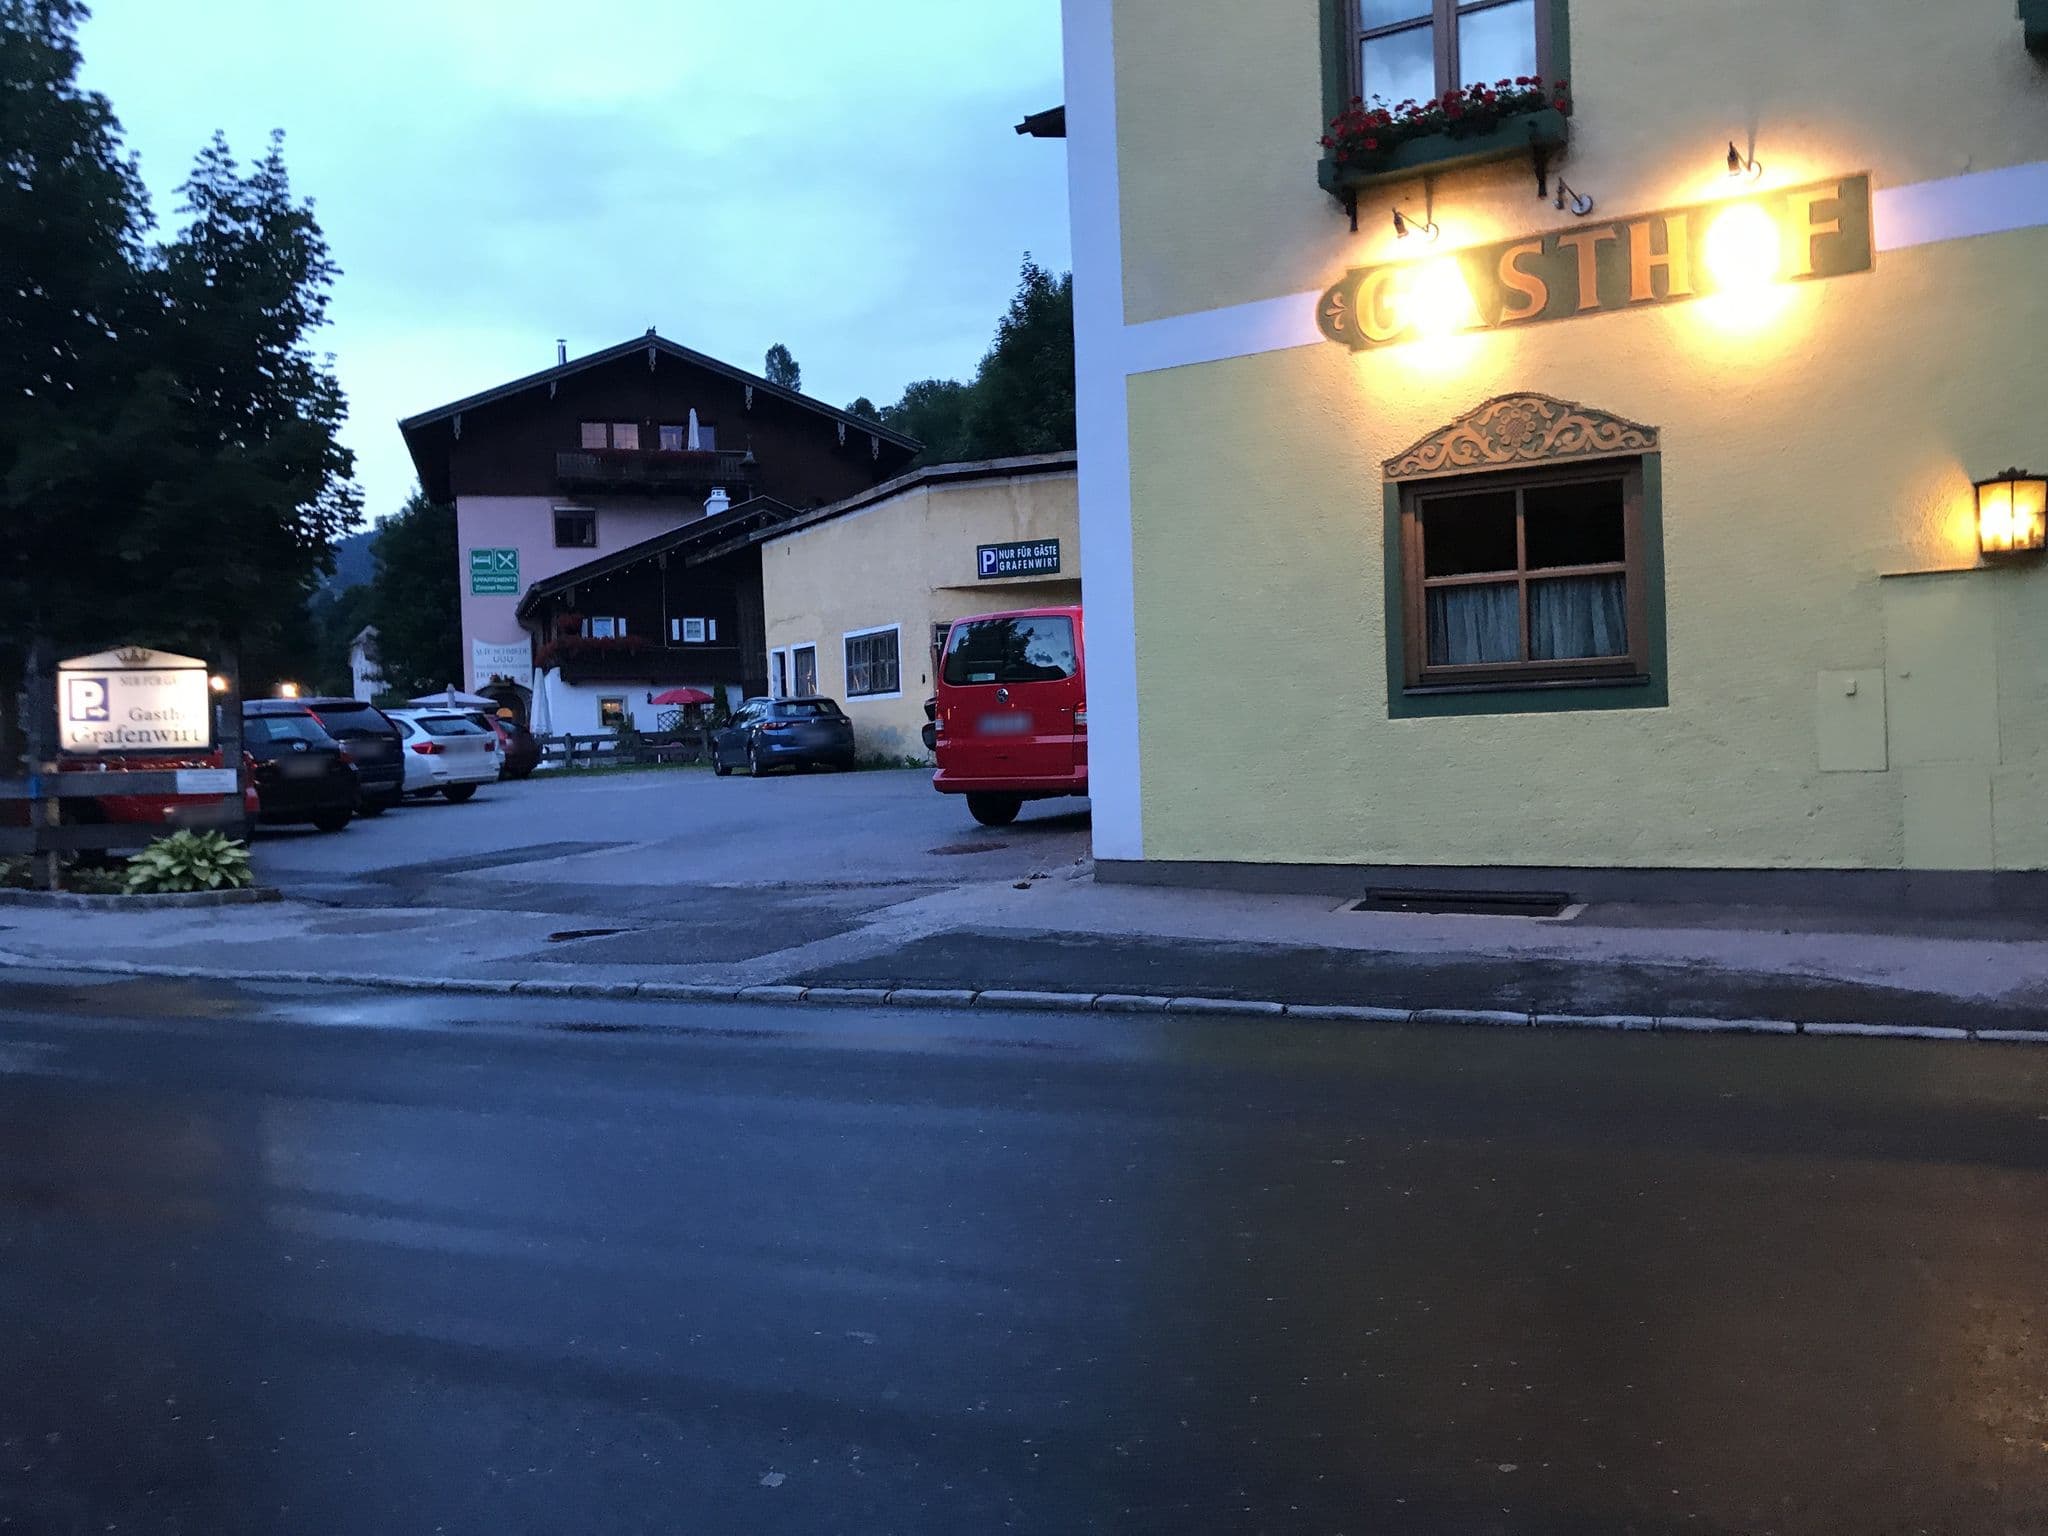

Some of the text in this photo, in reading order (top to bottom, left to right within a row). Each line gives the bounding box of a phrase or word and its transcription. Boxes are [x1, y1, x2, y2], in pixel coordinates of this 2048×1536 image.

[1355, 186, 1840, 342] GSTHF
[999, 544, 1057, 559] NUR FÜR GÄSTE
[982, 550, 996, 573] P
[999, 557, 1058, 571] GRAFENWIRT
